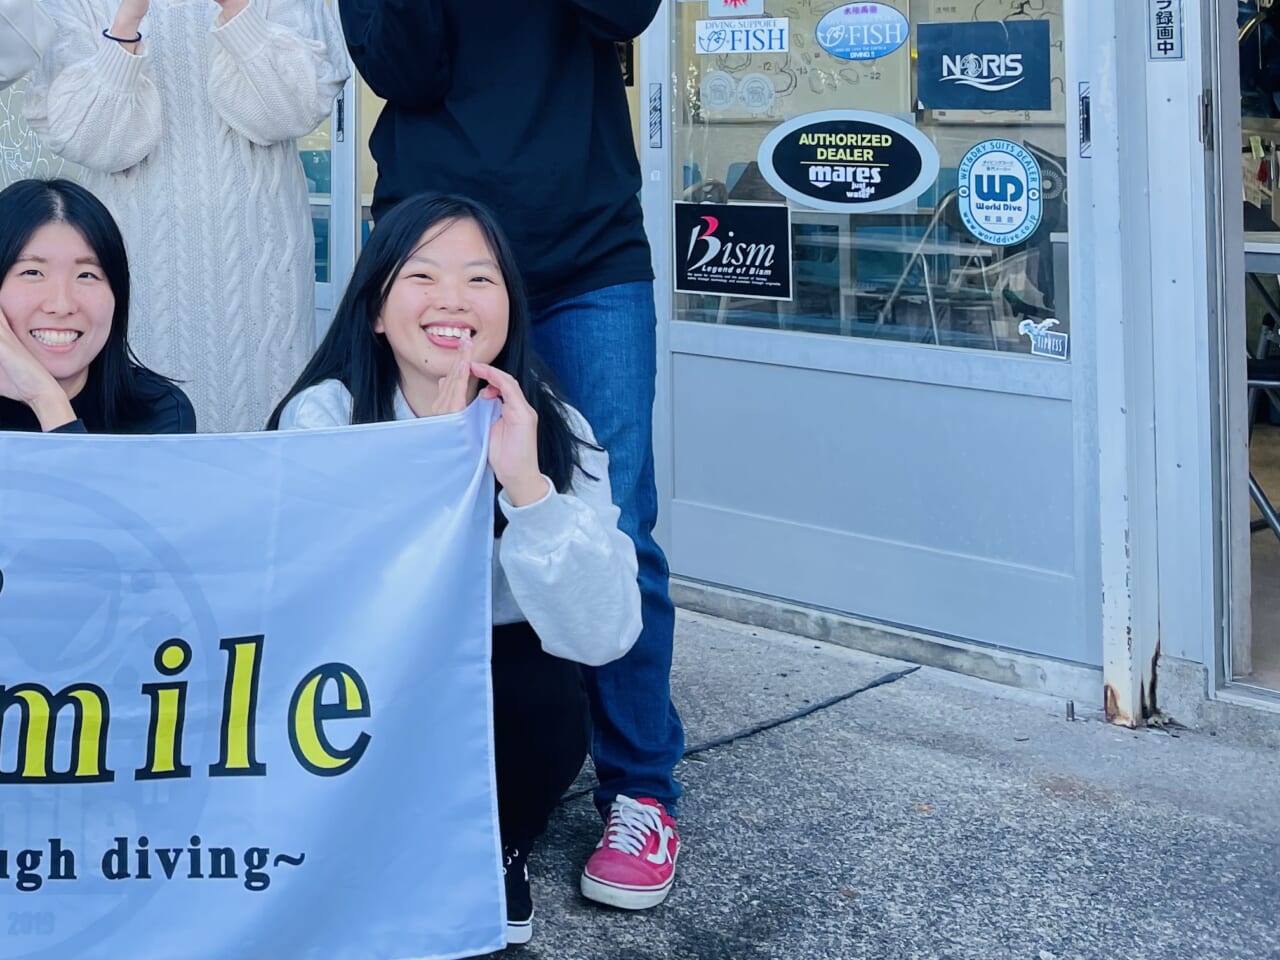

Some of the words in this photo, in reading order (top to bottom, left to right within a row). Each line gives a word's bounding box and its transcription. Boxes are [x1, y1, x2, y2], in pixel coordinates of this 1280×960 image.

[705, 21, 735, 30] DIVING
[738, 19, 776, 29] SUPPORT
[730, 28, 785, 51] FISH
[848, 23, 903, 46] FISH
[942, 53, 1023, 78] NORIS
[799, 133, 892, 147] AUTHORIZED
[817, 148, 874, 161] DEALER
[990, 142, 1015, 152] SUITS
[1017, 150, 1038, 182] DEALER
[809, 165, 881, 183] mares
[976, 203, 1001, 211] World
[1003, 203, 1022, 212] Dive
[687, 215, 776, 271] Bism
[701, 265, 734, 274] Legend
[748, 267, 772, 276] Bism
